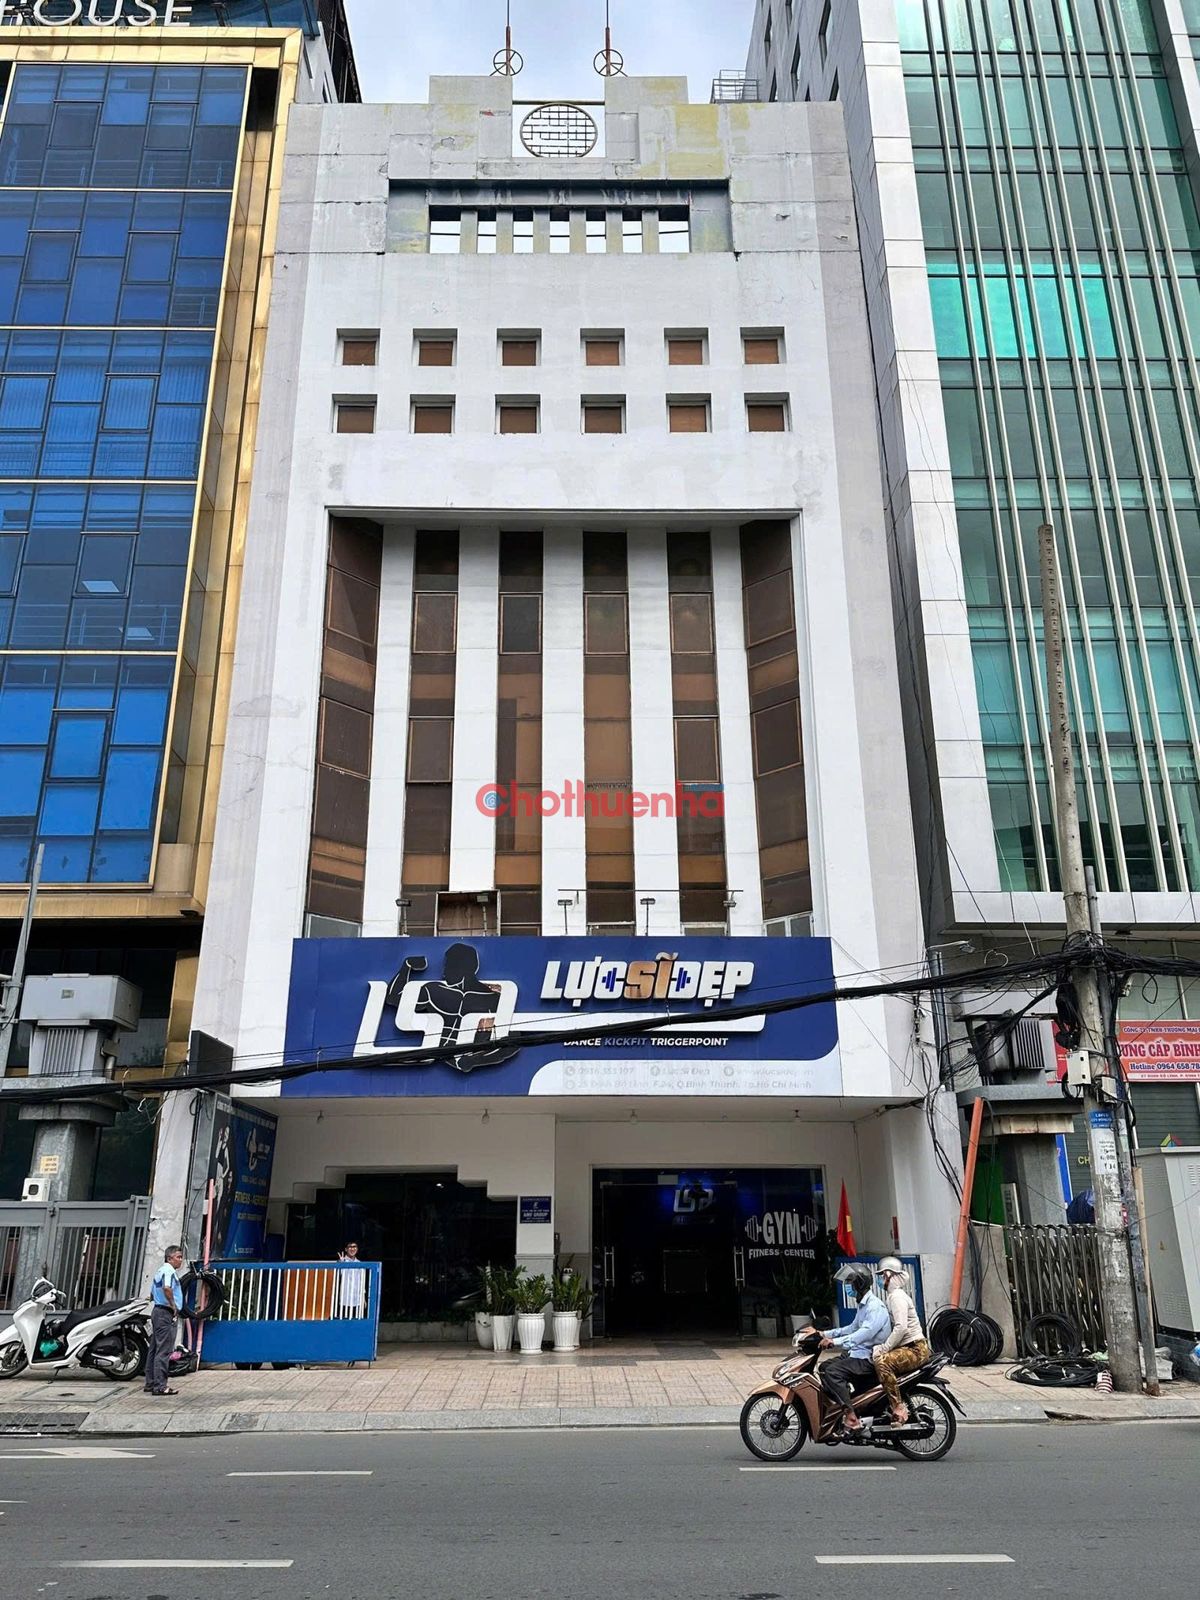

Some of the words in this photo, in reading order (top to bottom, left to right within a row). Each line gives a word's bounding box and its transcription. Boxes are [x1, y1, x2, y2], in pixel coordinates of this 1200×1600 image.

[604, 1037, 647, 1046] KICKFIT
[650, 1037, 728, 1046] TRIGGERPOINT
[1148, 1038, 1170, 1057] CẤP
[762, 1211, 801, 1245] GYM
[748, 1248, 780, 1260] FITNESS
[784, 1249, 816, 1260] CENTER
